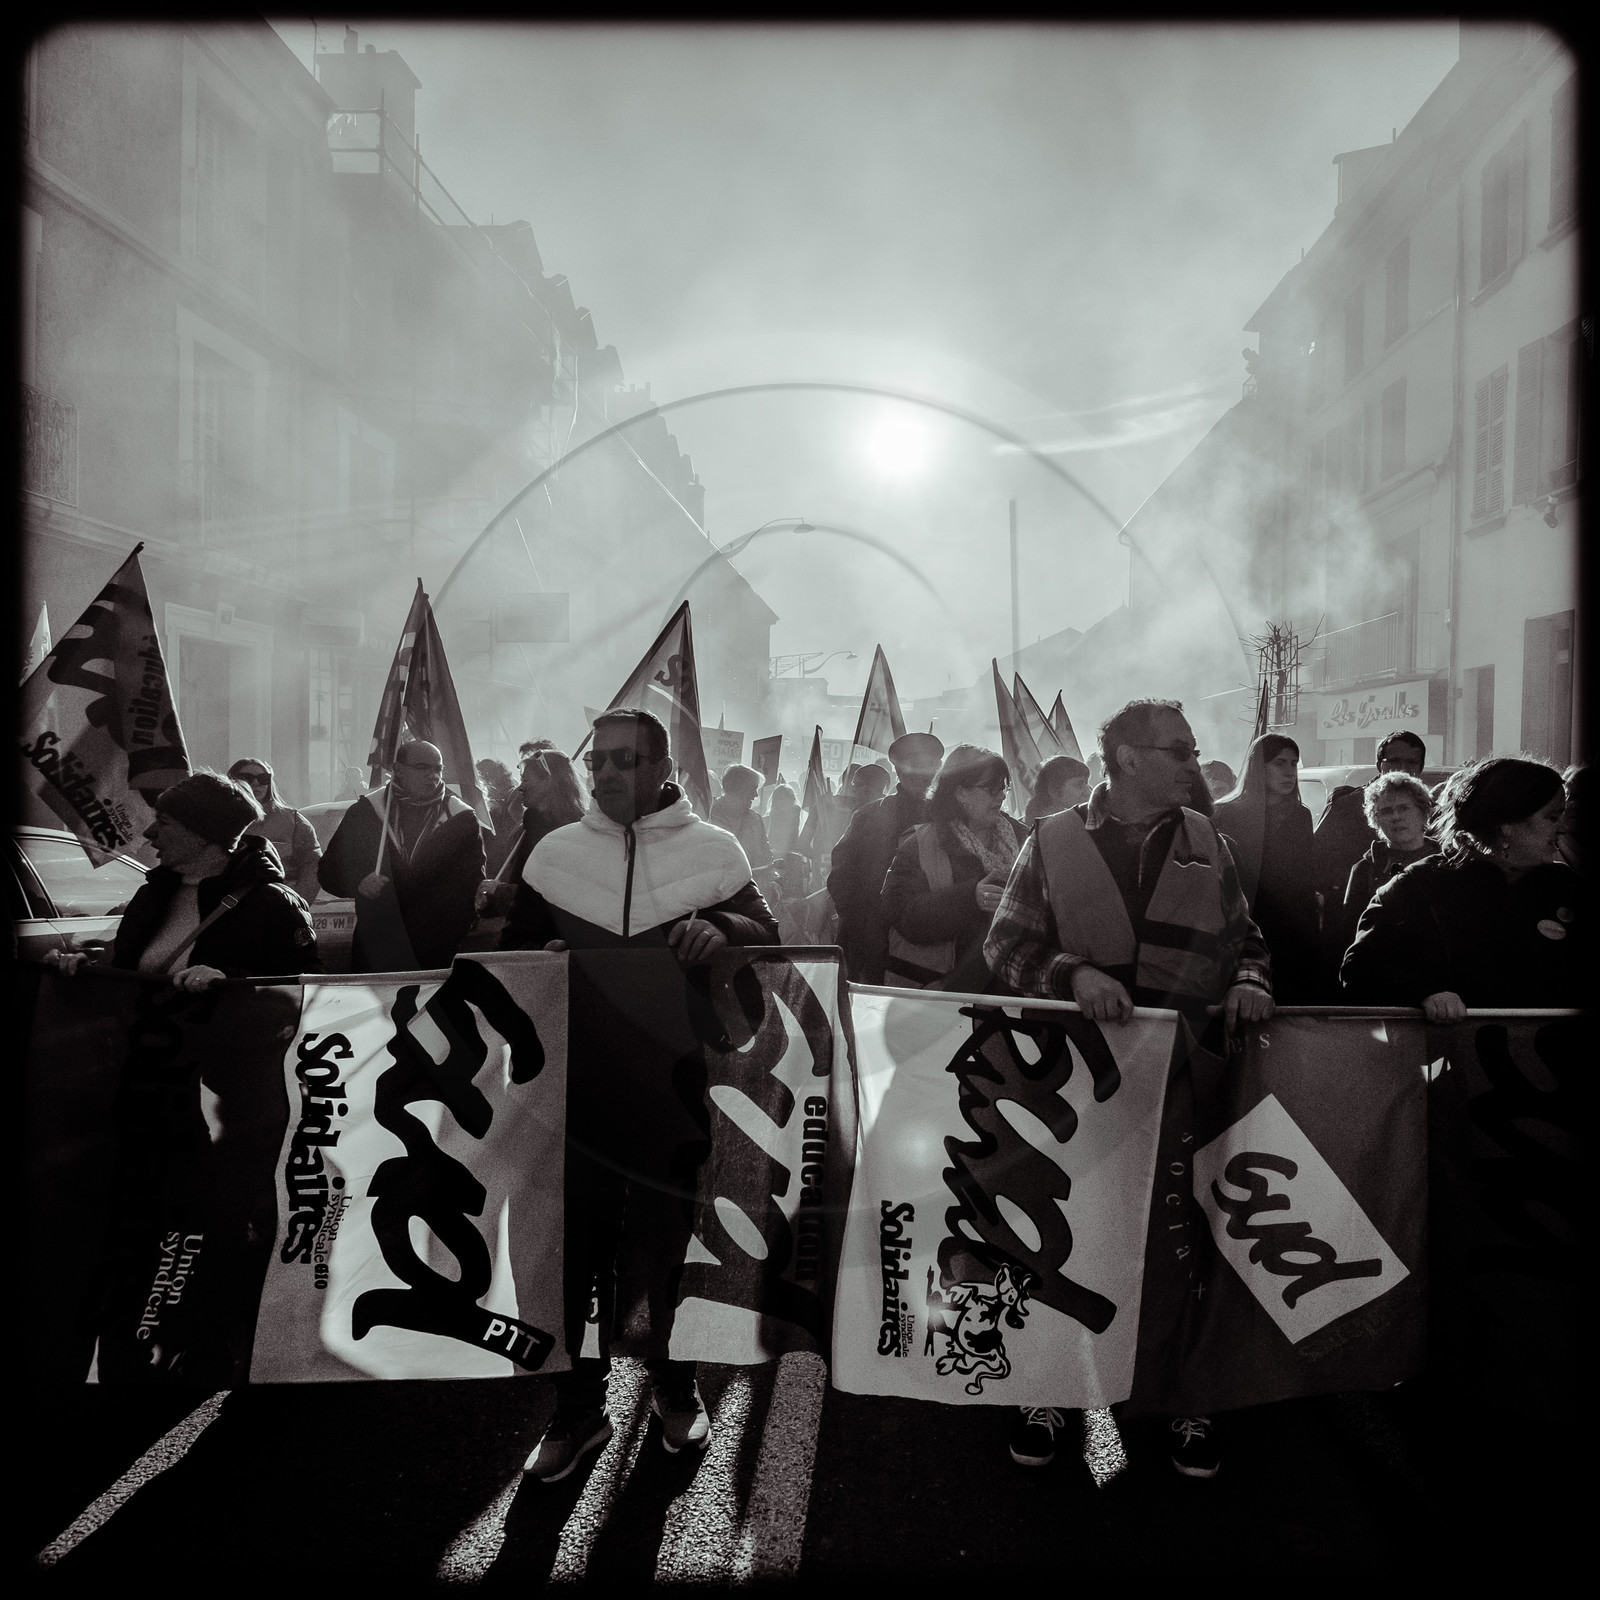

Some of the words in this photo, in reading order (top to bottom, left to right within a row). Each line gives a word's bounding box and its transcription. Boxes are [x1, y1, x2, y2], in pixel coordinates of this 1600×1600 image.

[1357, 691, 1420, 729] Gazelles
[717, 739, 740, 748] NOUS
[19, 731, 127, 853] Solidaires
[115, 803, 133, 829] Union
[280, 1032, 354, 1264] Solidaires
[328, 1194, 353, 1241] Union
[136, 1231, 181, 1340] syndicale
[165, 1232, 204, 1305] Union
[877, 1200, 915, 1357] Solidaires
[482, 1317, 542, 1361] PTT
[900, 1313, 910, 1358] syndicale
[906, 1314, 915, 1344] Union
